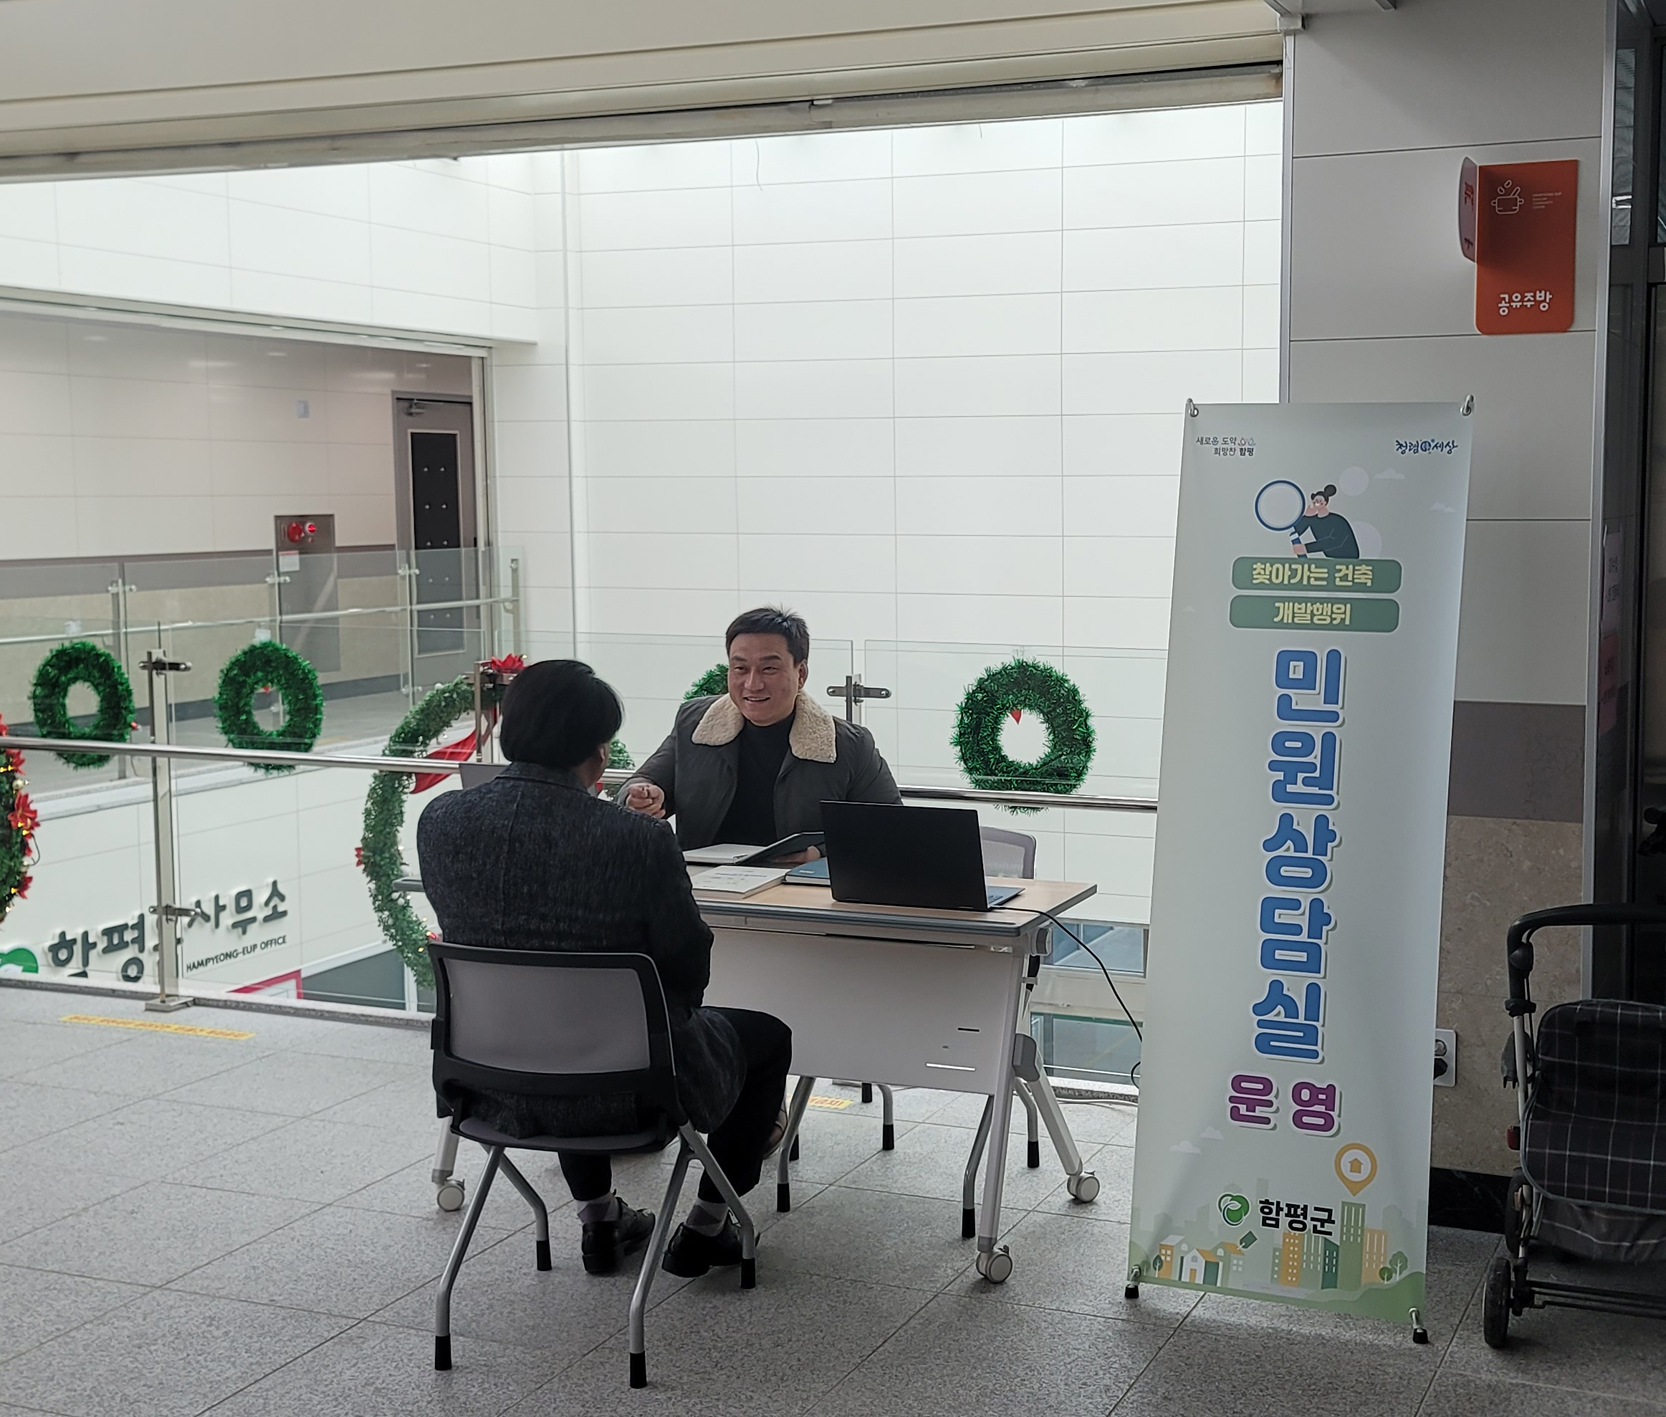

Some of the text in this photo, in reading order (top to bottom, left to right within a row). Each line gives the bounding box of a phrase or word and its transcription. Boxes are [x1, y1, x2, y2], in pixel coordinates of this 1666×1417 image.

[1498, 290, 1553, 316] 공유주방
[1213, 447, 1255, 457] 희망찬 함평
[1221, 436, 1237, 446] 도약
[1252, 562, 1373, 587] 찾아가는 건축
[1273, 601, 1351, 625] 개발행위
[1251, 648, 1342, 1061] 민원상담실
[48, 880, 288, 983] 함평사무소
[260, 935, 287, 951] OFFICE
[1258, 1198, 1336, 1236] 함평군
